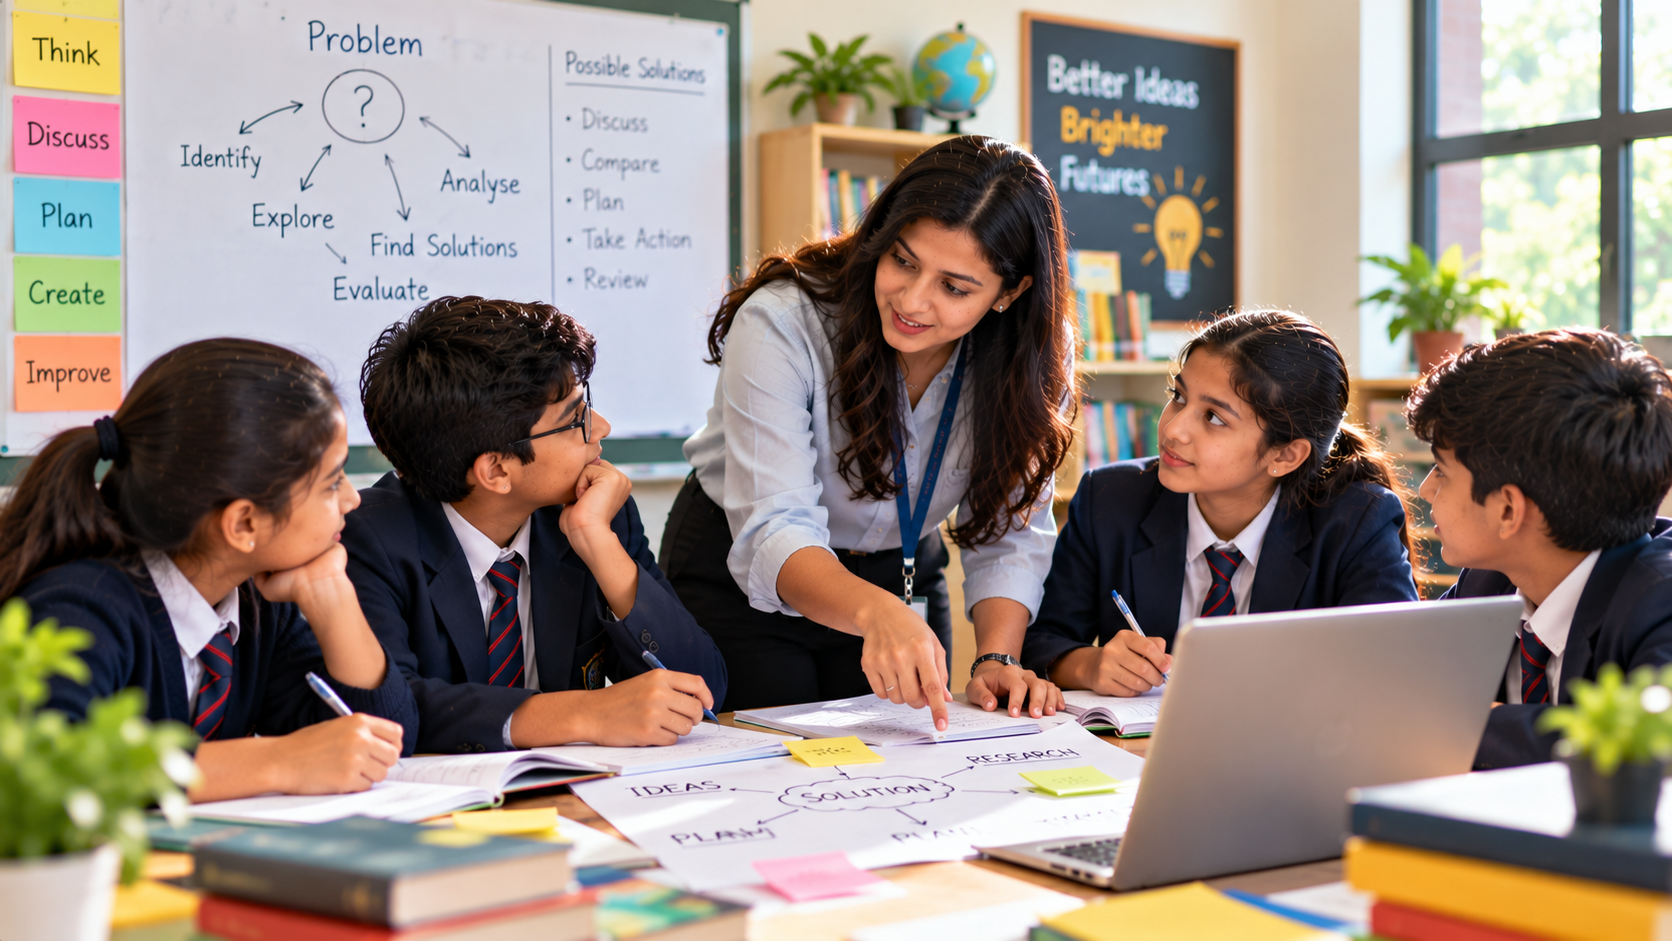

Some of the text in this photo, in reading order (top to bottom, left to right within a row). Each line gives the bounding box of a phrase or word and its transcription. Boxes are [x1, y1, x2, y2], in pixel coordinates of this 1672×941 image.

[32, 37, 100, 66] Think
[308, 20, 422, 56] Problem
[565, 50, 630, 78] Possible
[637, 56, 706, 84] Solutions
[1047, 54, 1200, 110] Better Ideas
[354, 85, 373, 128] ?
[581, 106, 649, 133] Discuss
[28, 121, 109, 150] Discuss
[1061, 105, 1169, 157] Brighter
[181, 145, 261, 178] Identify
[581, 147, 660, 181] Compare
[1060, 155, 1150, 197] Futures
[441, 169, 520, 204] Analyse
[582, 187, 624, 211] Plan
[42, 202, 92, 228] Plan
[253, 203, 334, 238] Explore
[371, 233, 517, 258] Find Solutions
[582, 227, 692, 250] Take Action
[29, 280, 105, 305] Create
[334, 276, 430, 301] Evaluate
[583, 266, 648, 290] Review
[26, 360, 111, 392] Improve
[966, 748, 1080, 765] RESEARCH
[625, 780, 721, 797] IDEAS
[800, 781, 932, 805] SOLUTION
